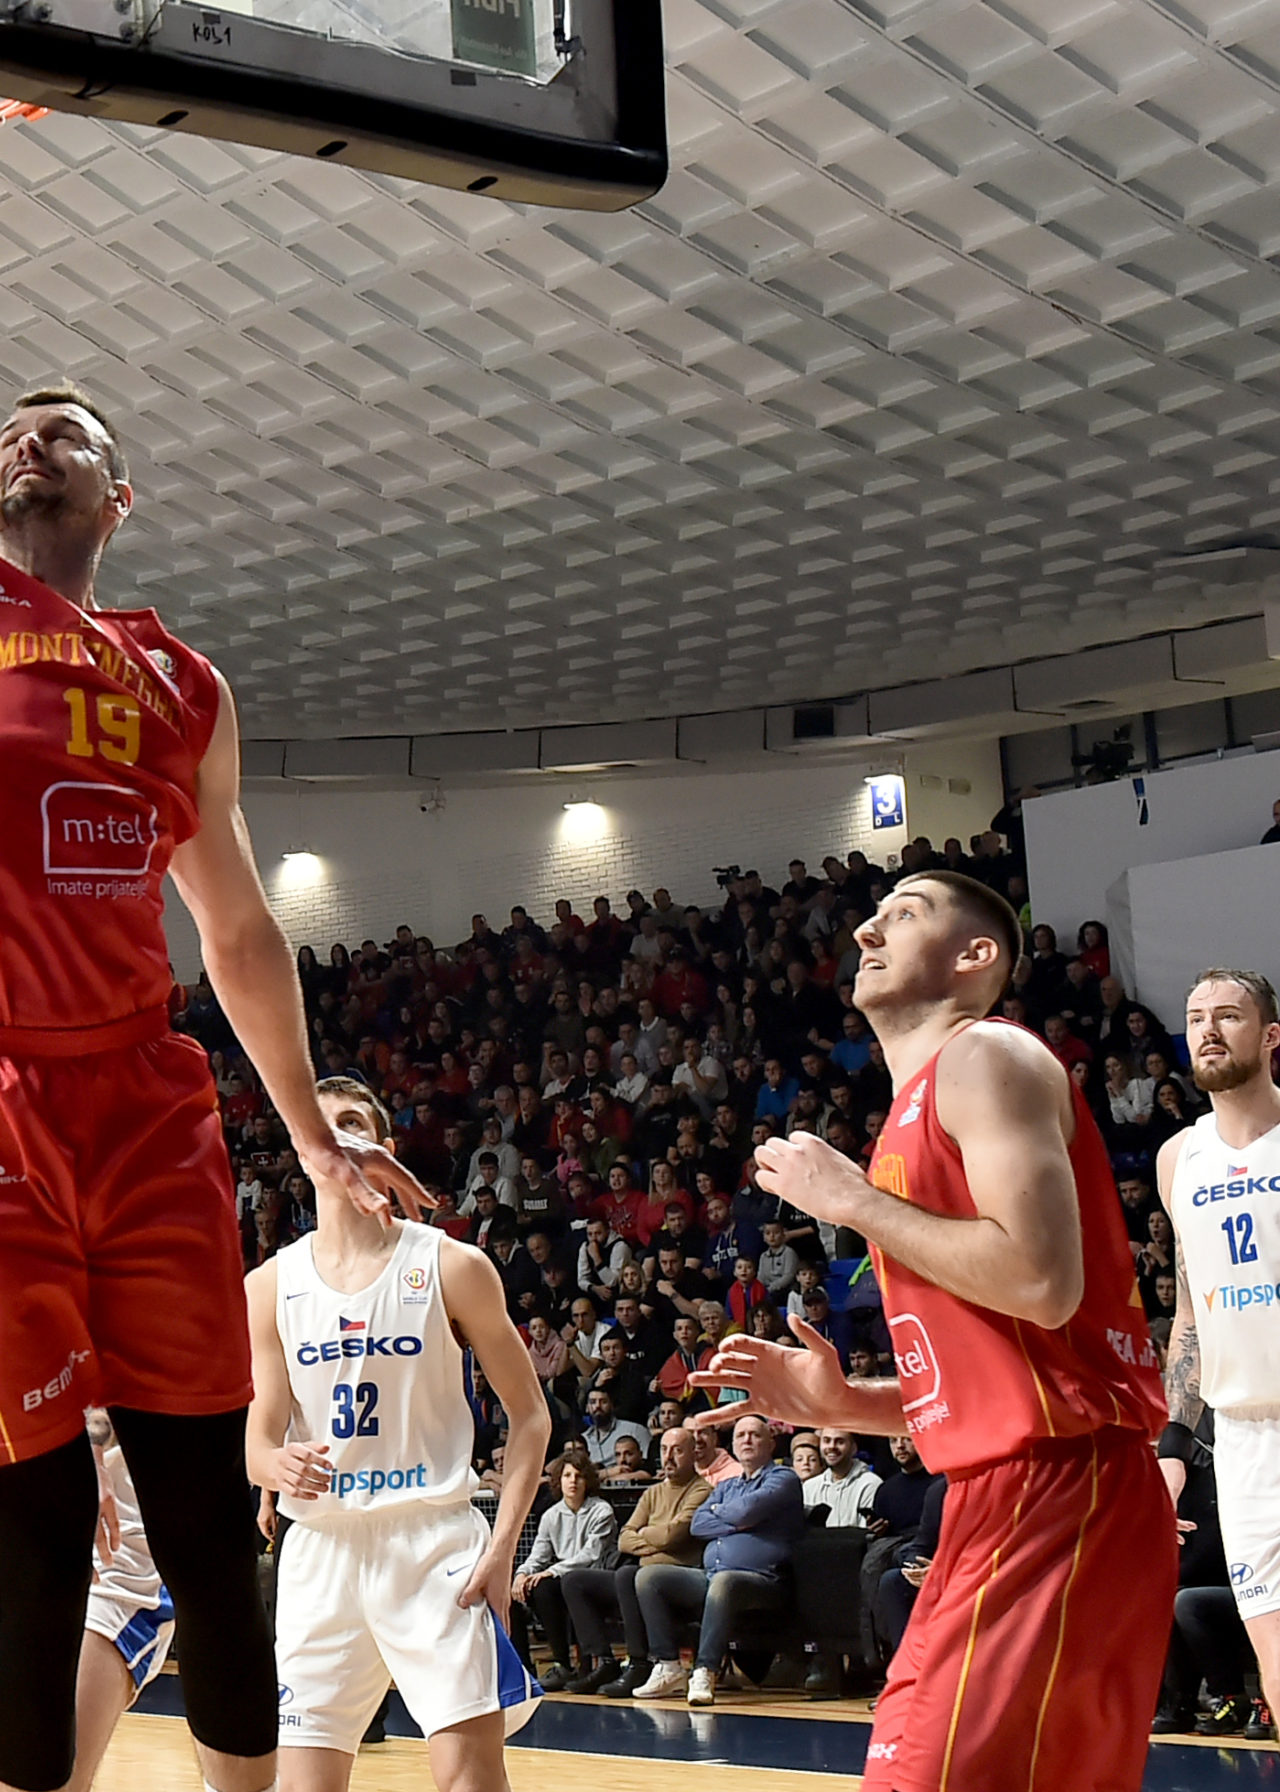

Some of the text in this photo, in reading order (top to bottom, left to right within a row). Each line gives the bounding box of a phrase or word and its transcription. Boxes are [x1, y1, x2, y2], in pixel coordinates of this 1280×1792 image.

[63, 688, 140, 766] 19
[876, 784, 897, 814] 3
[63, 813, 145, 844] m:tel
[47, 877, 93, 895] Imate
[1221, 1212, 1258, 1265] 12
[297, 1336, 423, 1366] ČESKO
[331, 1382, 379, 1439] 32
[329, 1463, 427, 1499] ipsport
